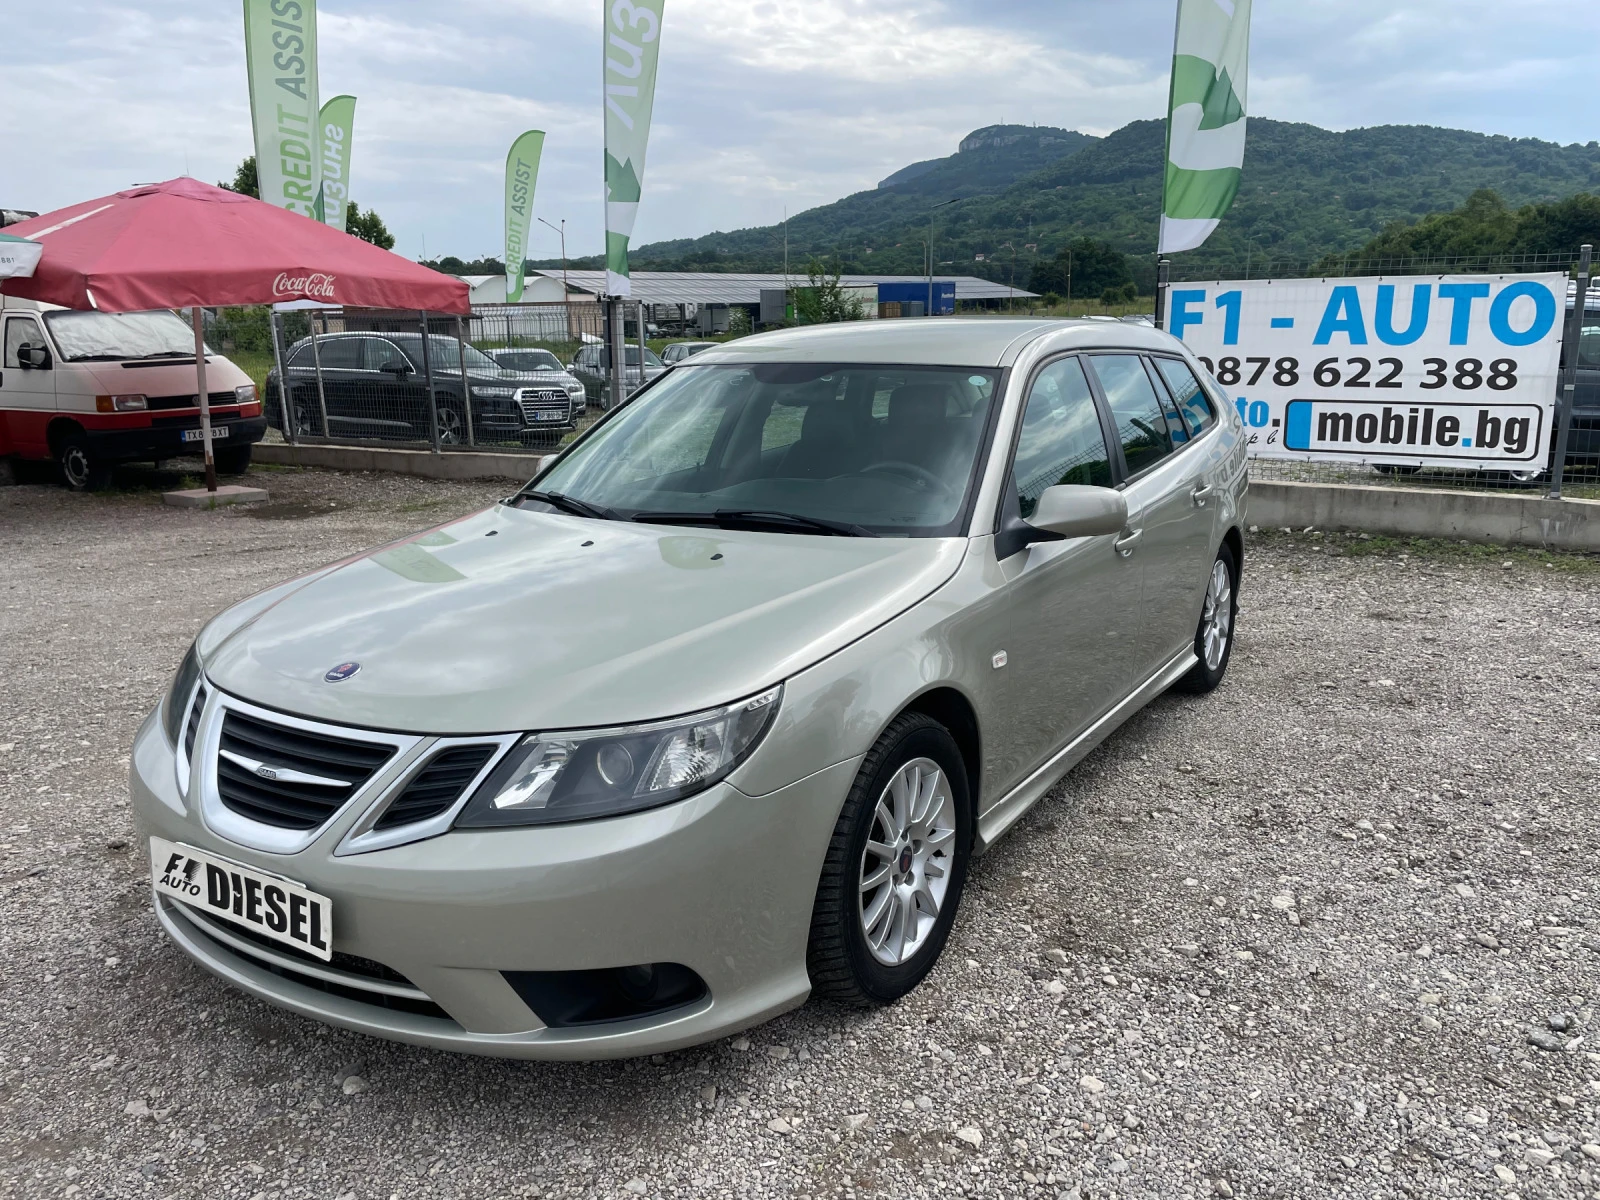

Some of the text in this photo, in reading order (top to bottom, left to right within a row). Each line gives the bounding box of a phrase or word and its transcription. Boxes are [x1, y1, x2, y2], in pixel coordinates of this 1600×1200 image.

[506, 157, 532, 275] CREDIT ASSIST
[1170, 289, 1242, 345] F1
[1312, 281, 1557, 347] AUTO
[1313, 357, 1404, 388] 622
[1419, 357, 1518, 391] 388
[1317, 406, 1531, 454] mobile.bg
[159, 874, 201, 897] AUTO
[205, 862, 327, 952] DIESEL
